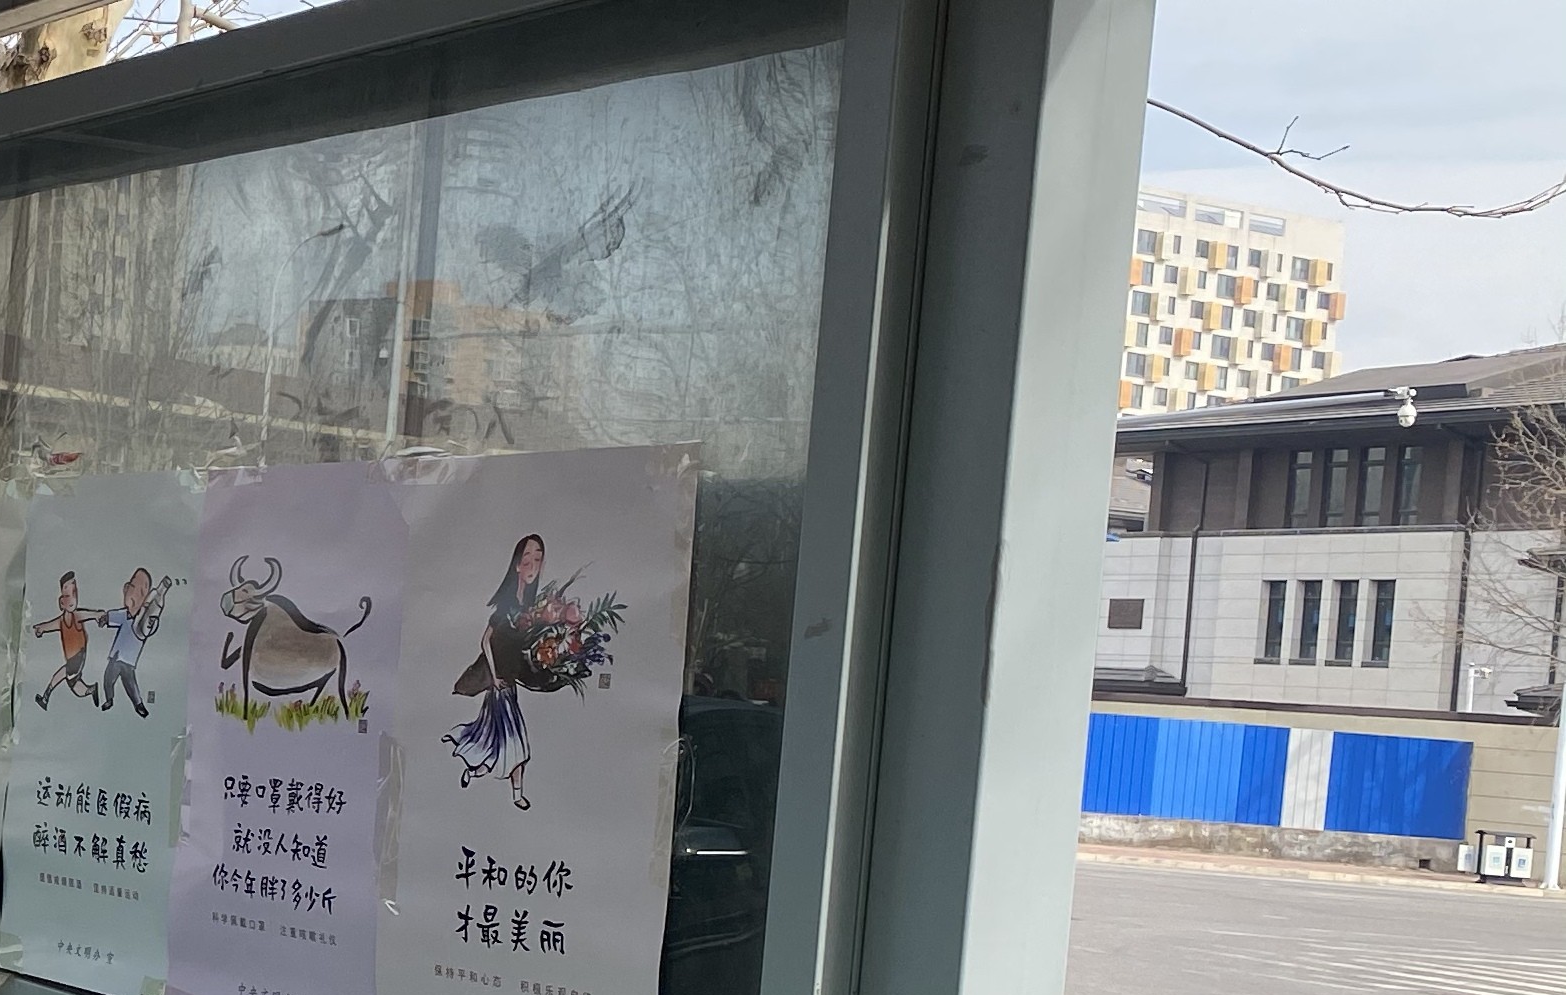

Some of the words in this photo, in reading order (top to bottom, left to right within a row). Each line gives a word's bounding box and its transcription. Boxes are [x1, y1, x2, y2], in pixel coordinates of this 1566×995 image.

[36, 776, 152, 826] 运动能医假病
[224, 775, 347, 815] 只要口罩戴得好
[34, 822, 149, 874] 醉酒不解真愁
[233, 823, 328, 869] 就没人知道
[212, 863, 337, 915] 你今年胖了多少斤
[455, 846, 574, 898] 平和的你
[455, 904, 565, 955] 才最美丽
[434, 964, 502, 988] 保持平和心态
